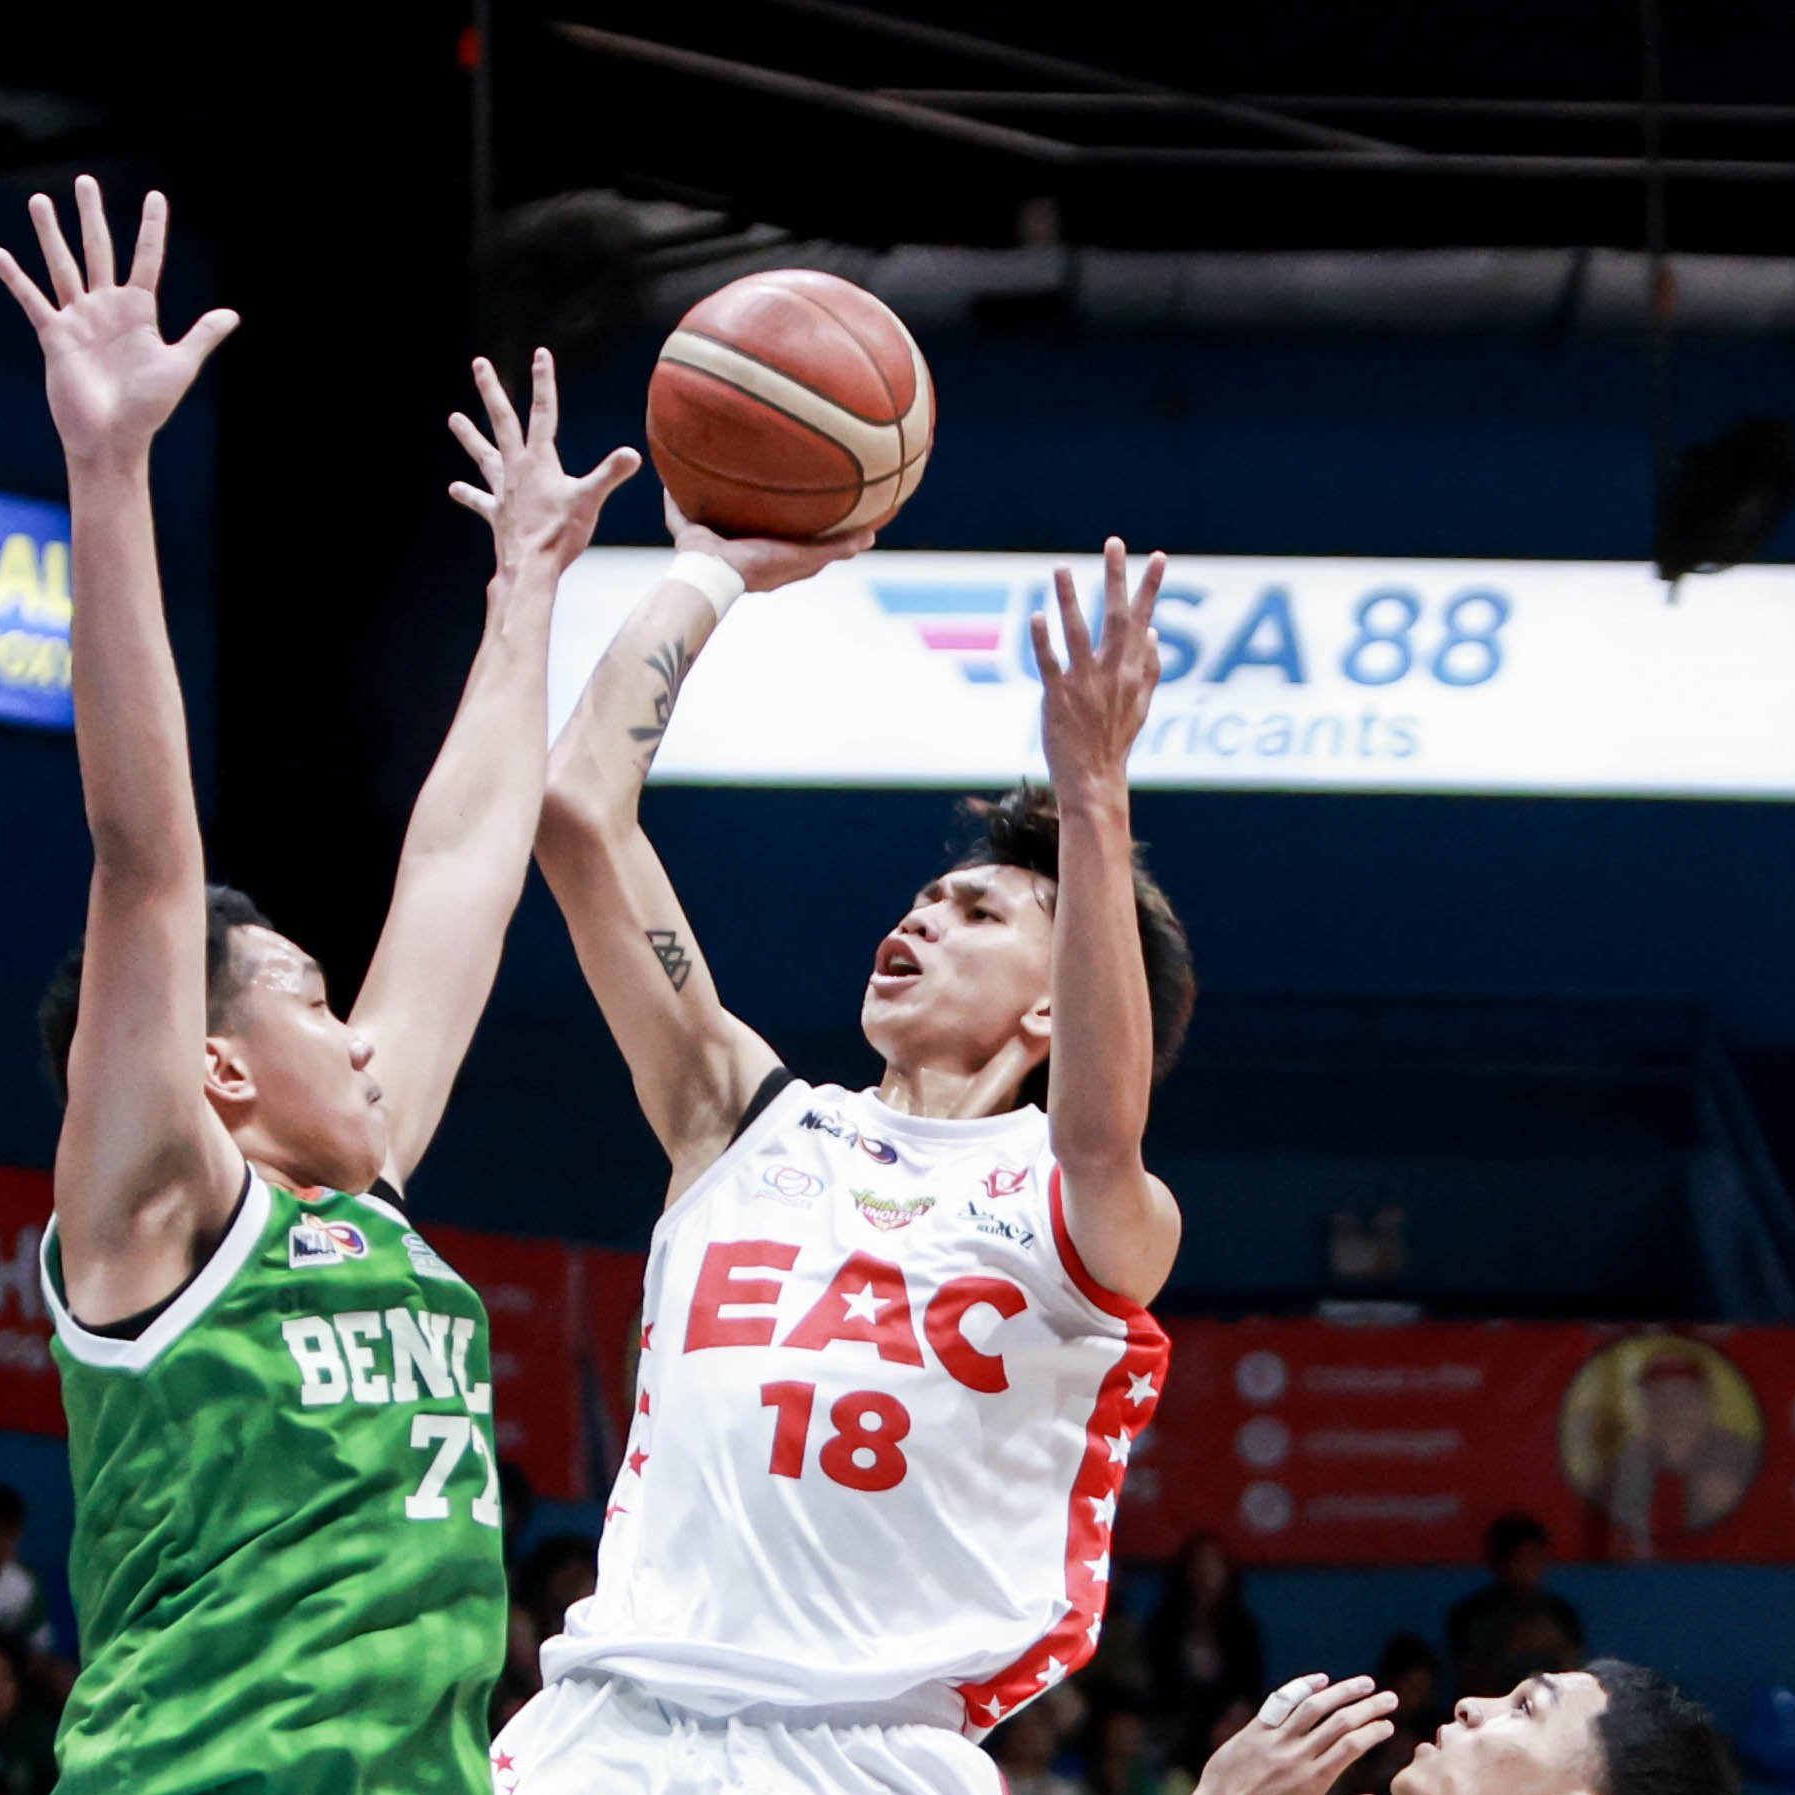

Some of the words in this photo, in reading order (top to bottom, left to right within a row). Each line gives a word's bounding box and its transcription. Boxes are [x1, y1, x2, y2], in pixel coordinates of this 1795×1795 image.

[1341, 583, 1512, 688] 88
[683, 1240, 1027, 1393] EAC
[760, 1380, 911, 1491] 18
